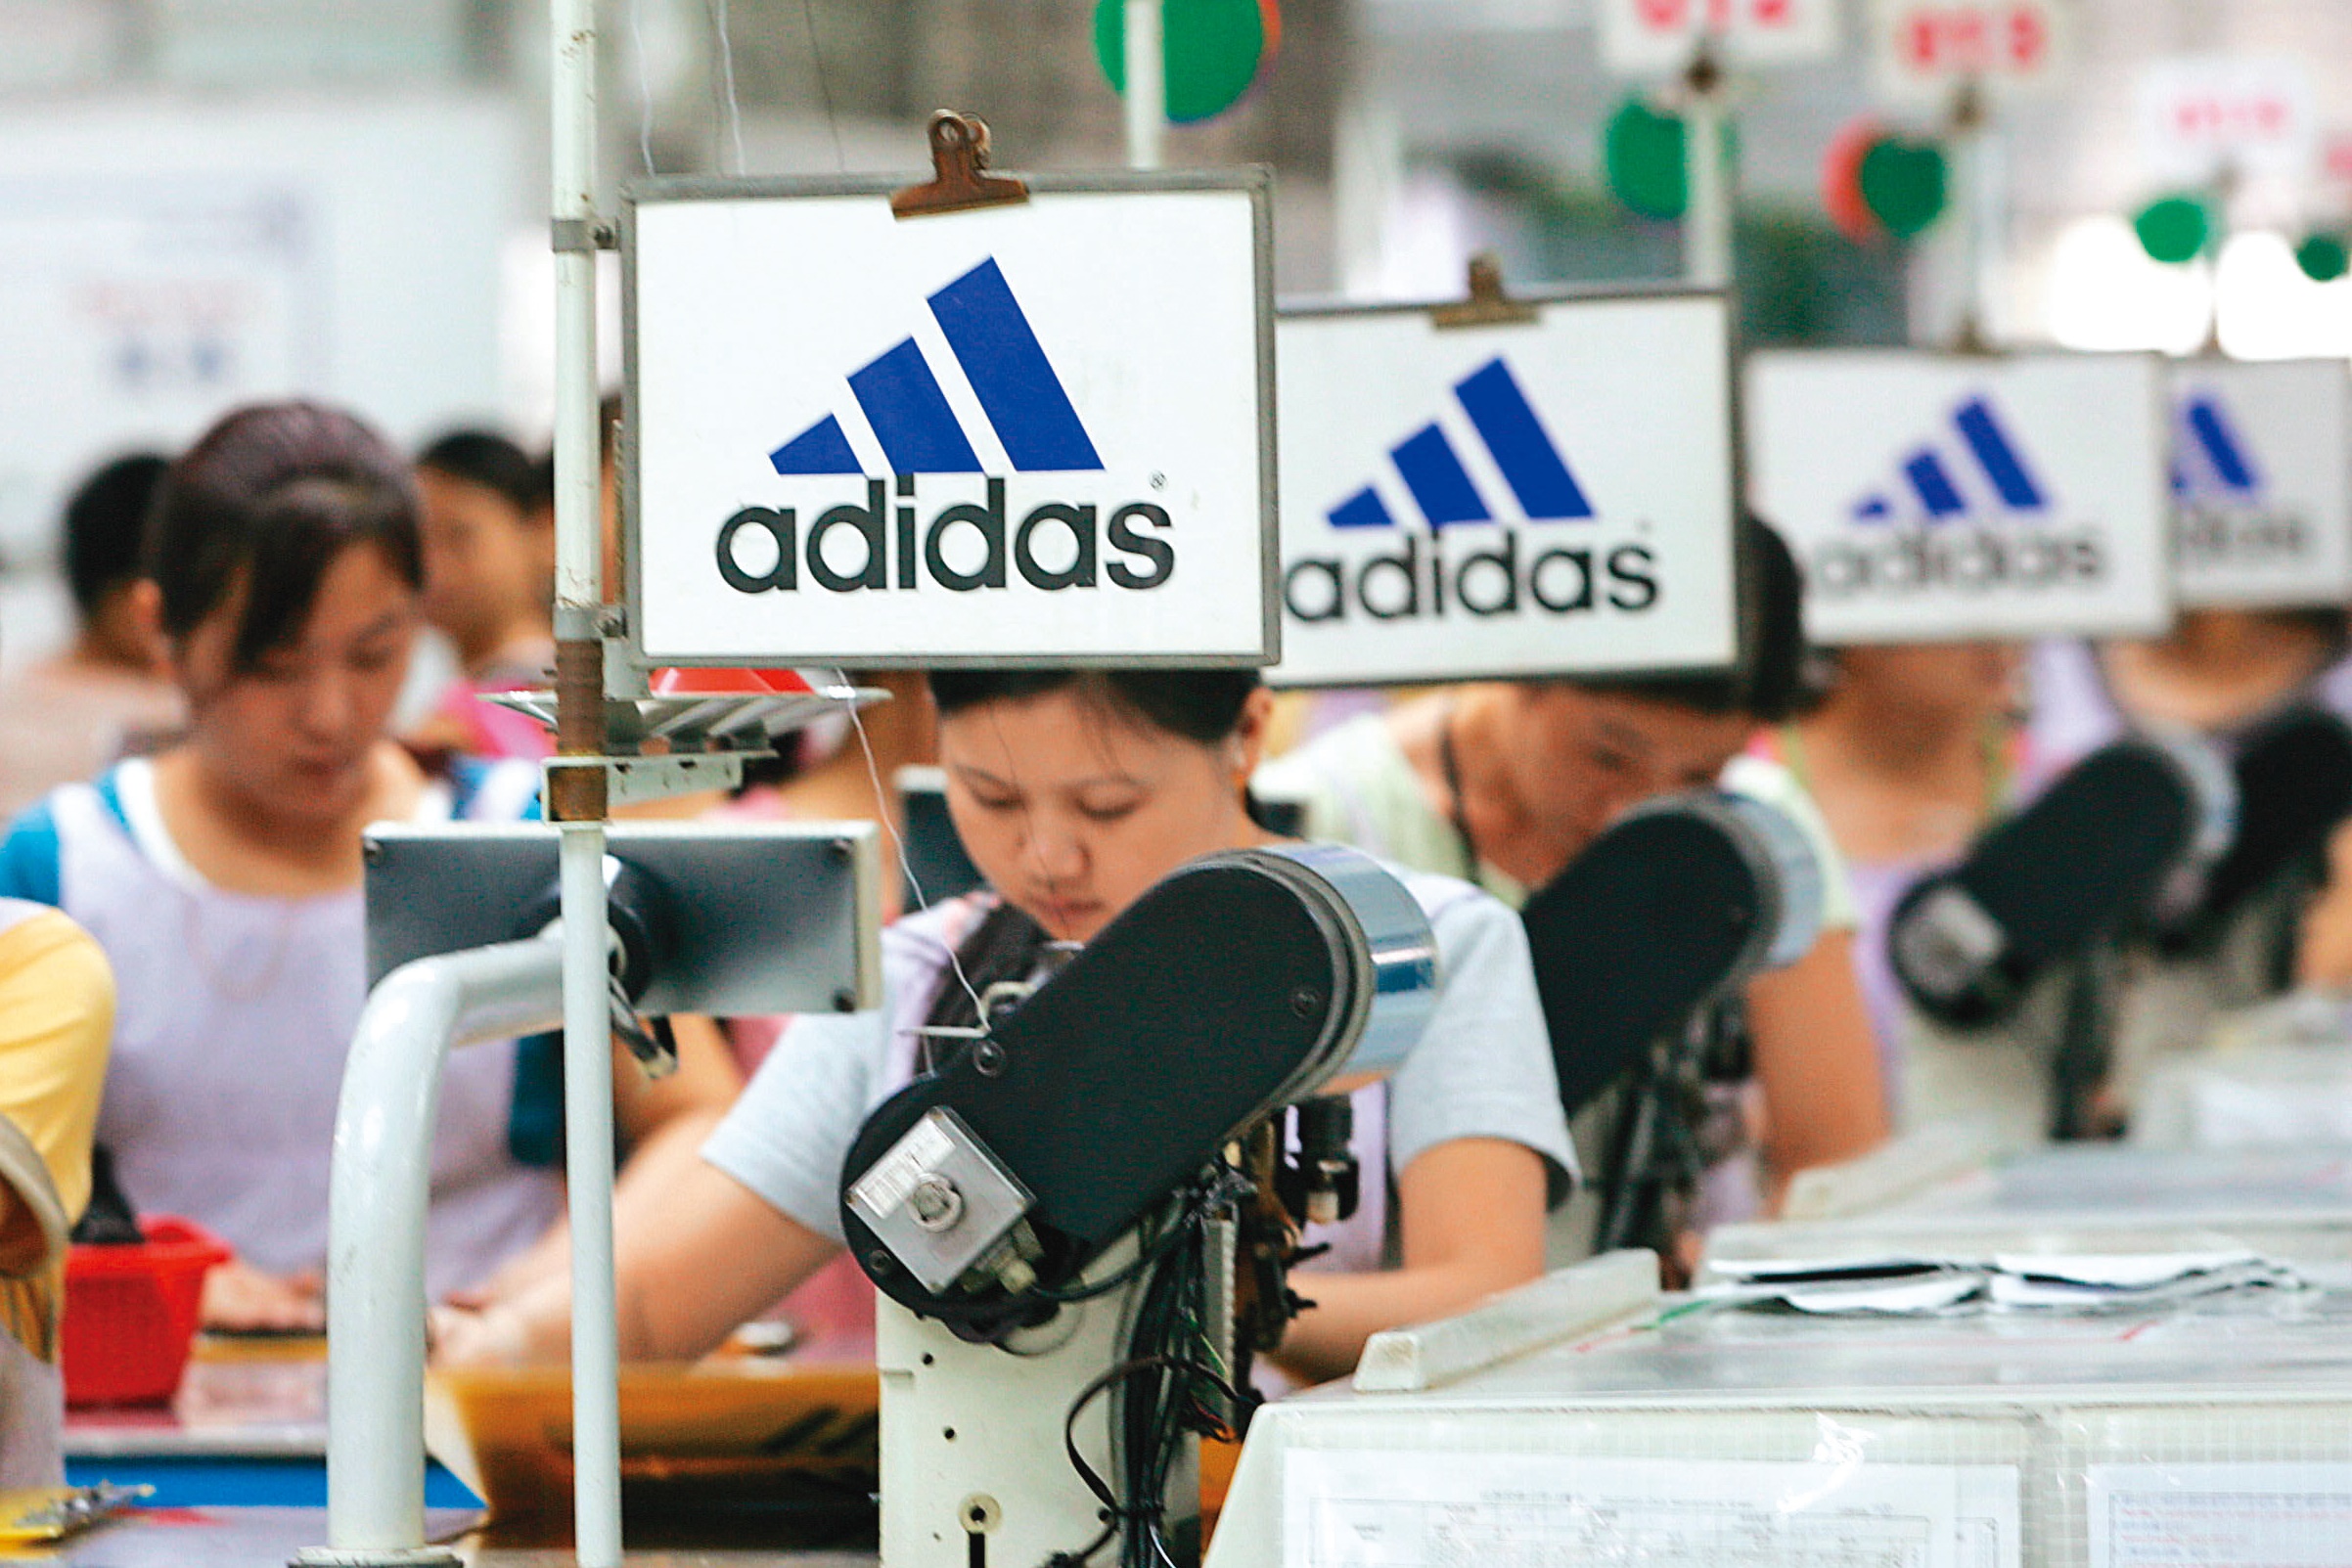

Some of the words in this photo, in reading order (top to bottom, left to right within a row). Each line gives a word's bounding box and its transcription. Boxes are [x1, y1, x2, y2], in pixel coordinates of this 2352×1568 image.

[716, 472, 1175, 594] adidas
[1284, 526, 1658, 622] adidas
[1811, 525, 2106, 593] adidas
